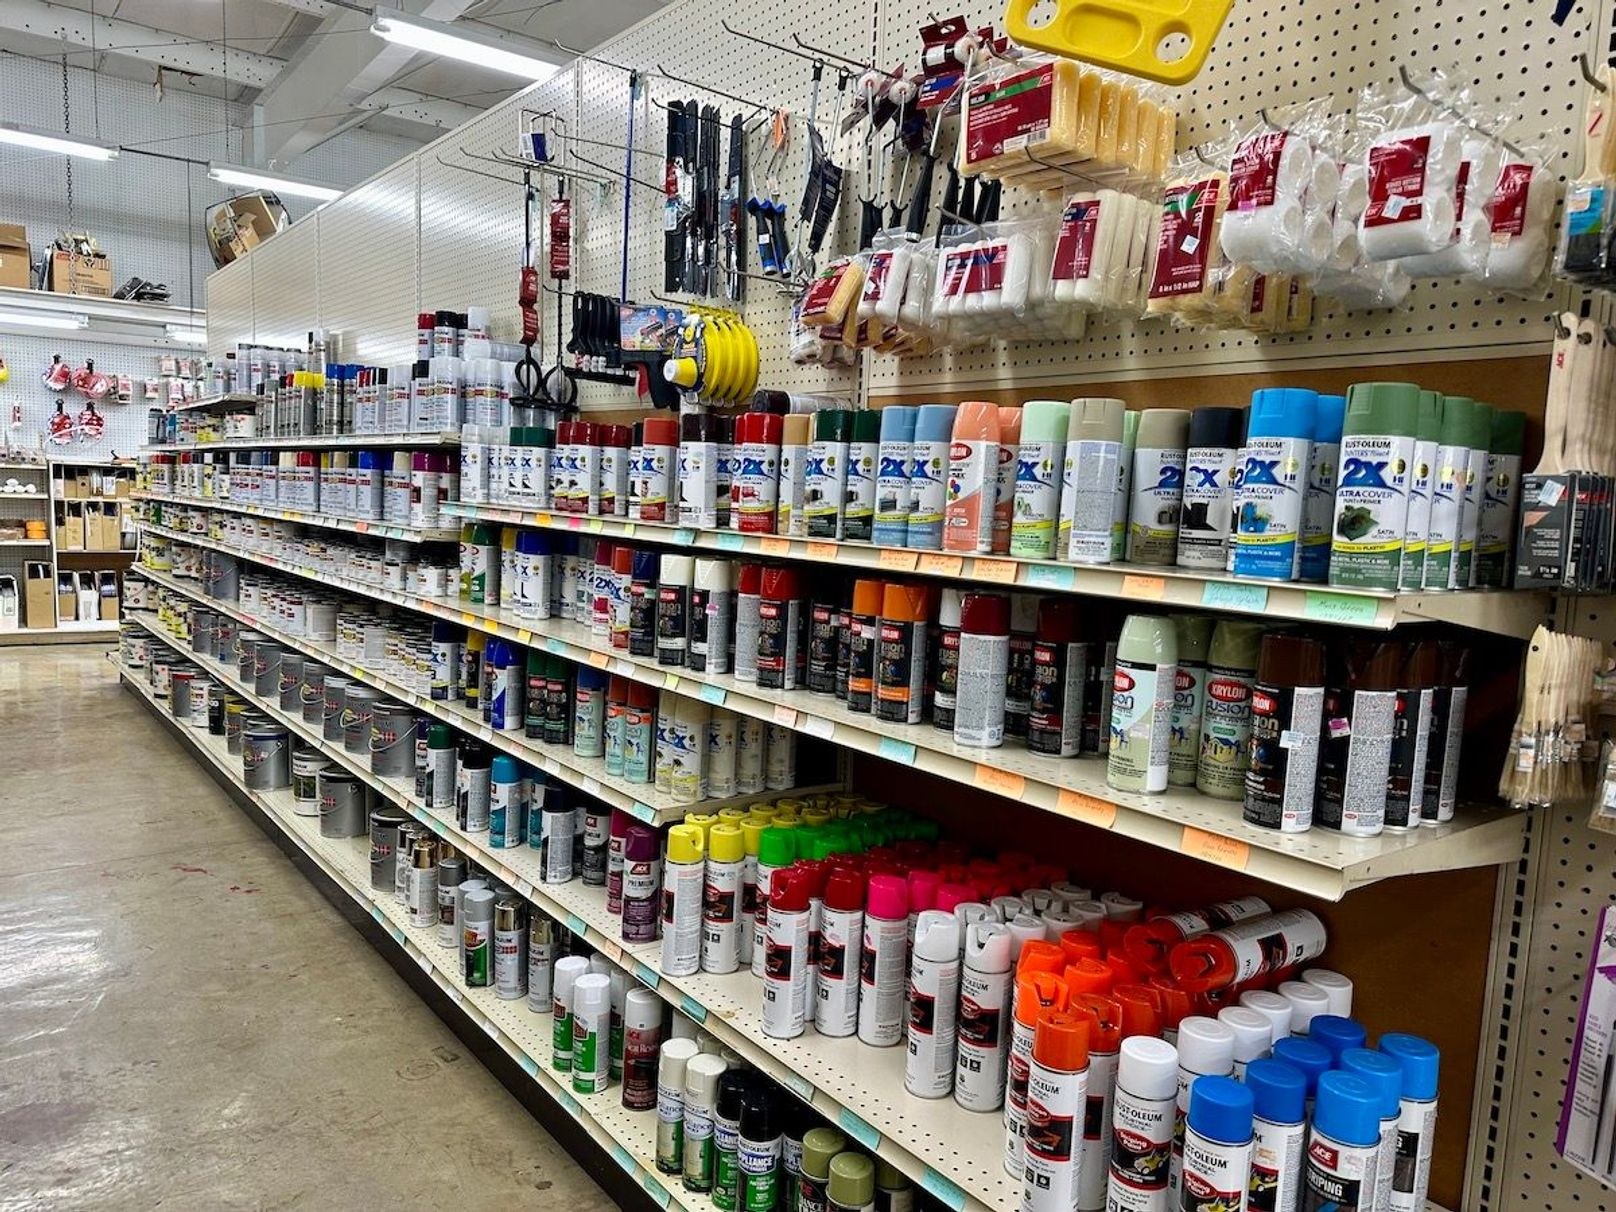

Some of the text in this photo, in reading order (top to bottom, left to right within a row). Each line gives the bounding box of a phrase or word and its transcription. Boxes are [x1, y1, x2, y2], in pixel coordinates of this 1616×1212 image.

[741, 457, 766, 475] 2X
[880, 456, 906, 477] 2X
[1244, 457, 1281, 484] 2X
[1343, 457, 1389, 487] 2X
[1212, 683, 1248, 699] KRYLON
[627, 879, 654, 887] PREMIUM
[740, 1153, 773, 1167] PLIANCE
[1185, 1144, 1227, 1169] ST-OLEUM
[1313, 1144, 1333, 1161] ACE
